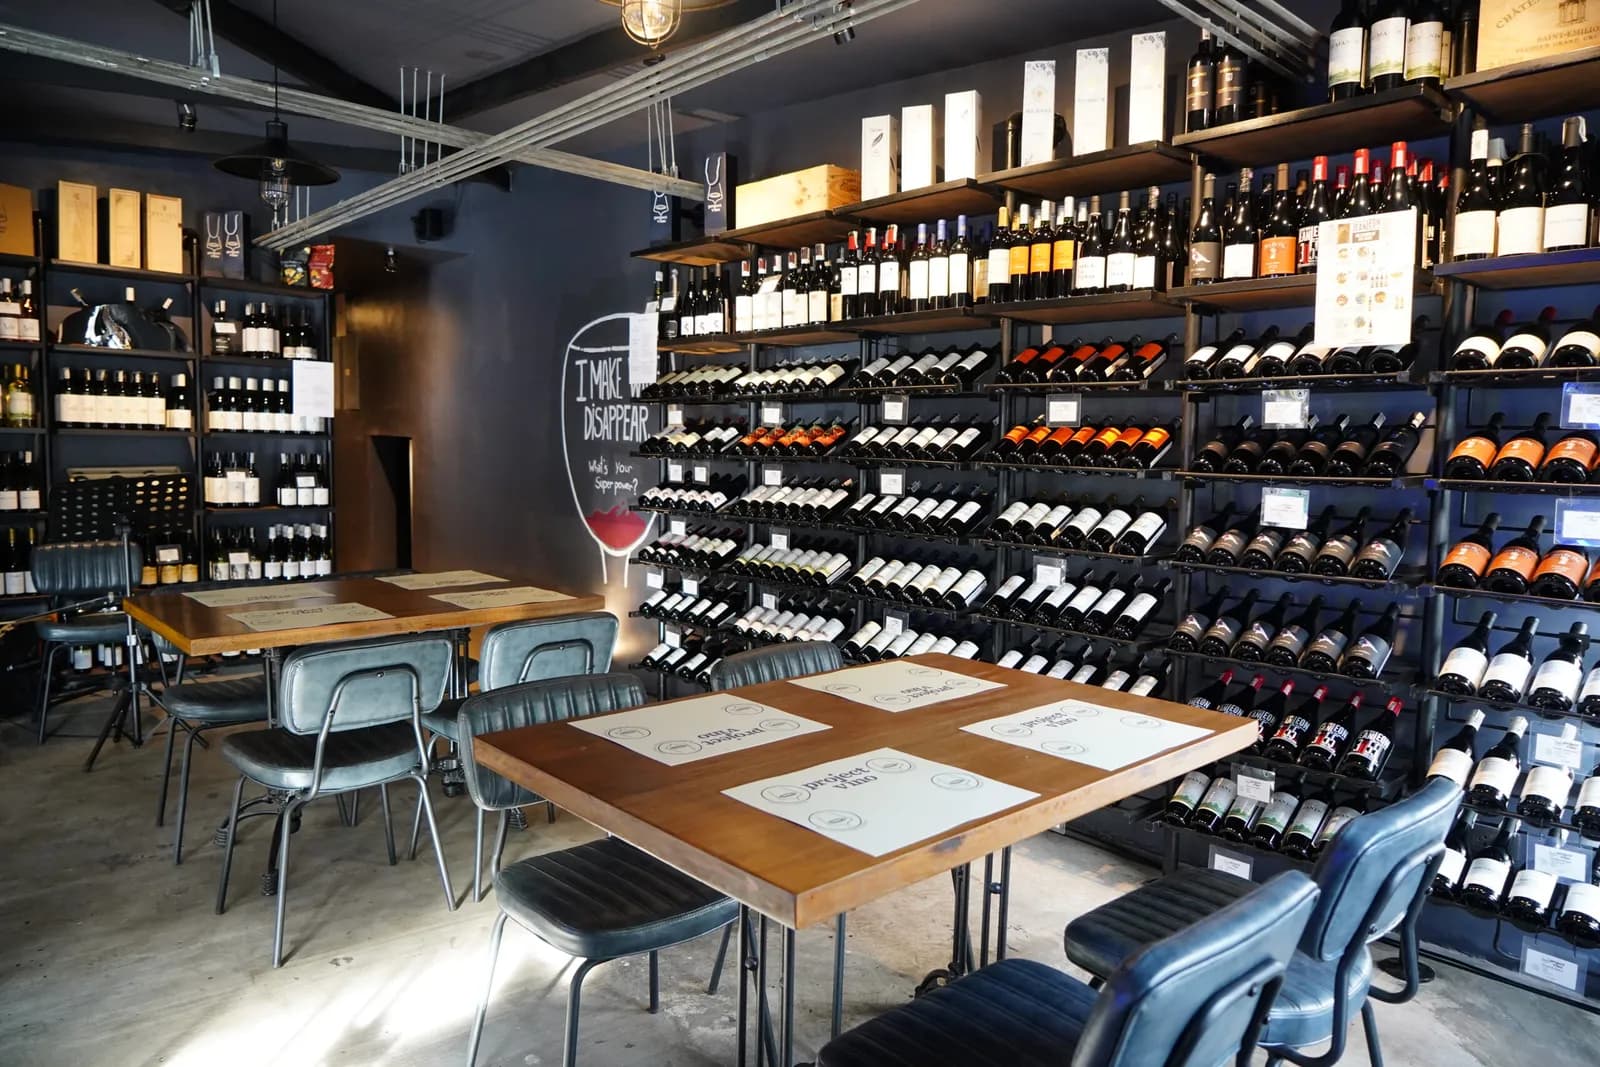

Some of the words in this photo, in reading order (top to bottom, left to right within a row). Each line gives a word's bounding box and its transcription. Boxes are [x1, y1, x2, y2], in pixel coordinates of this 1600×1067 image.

[575, 359, 588, 402] I
[590, 357, 623, 400] MAKE
[802, 767, 872, 791] project
[832, 774, 879, 790] vino
